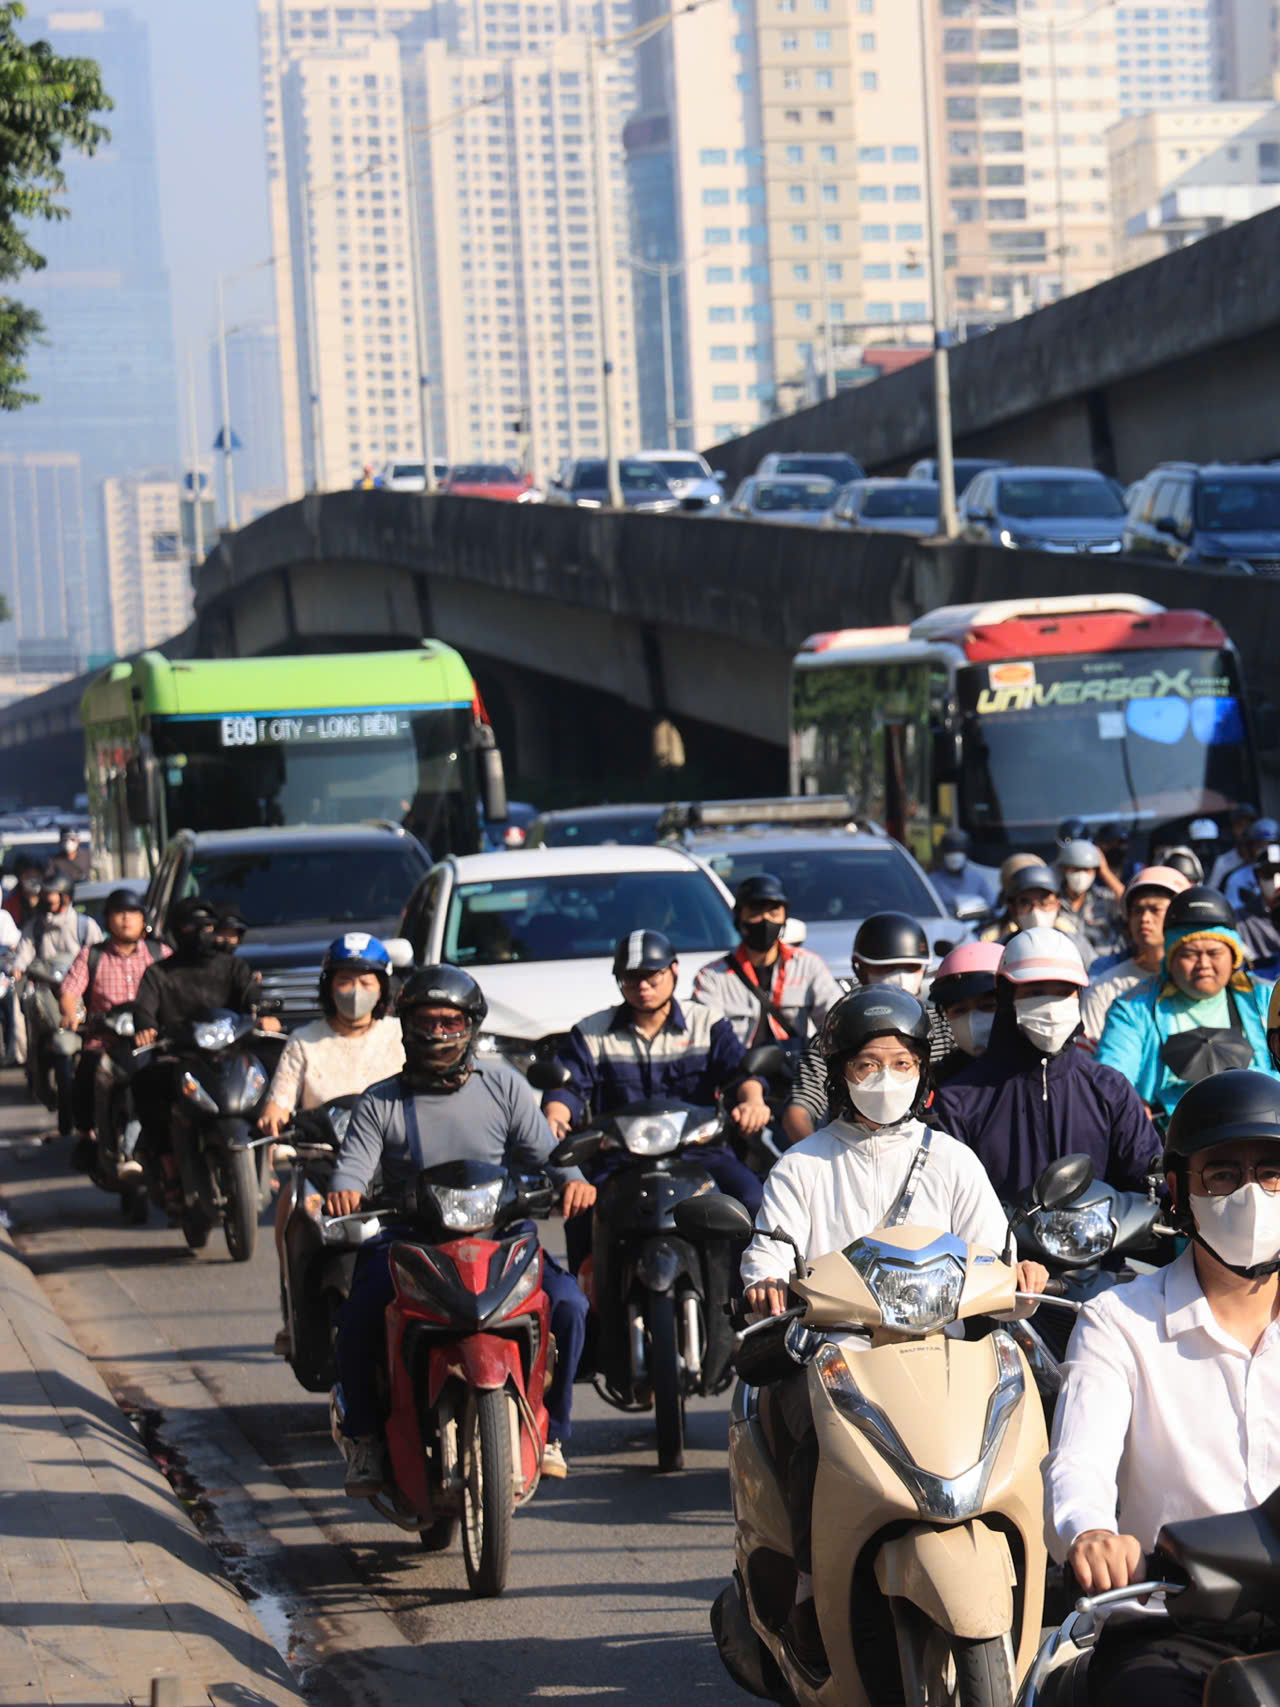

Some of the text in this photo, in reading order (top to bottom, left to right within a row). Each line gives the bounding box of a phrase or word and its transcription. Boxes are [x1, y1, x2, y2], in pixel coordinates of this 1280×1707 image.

[221, 715, 257, 746] E09
[270, 718, 303, 741] CITY
[318, 714, 360, 738] LONG
